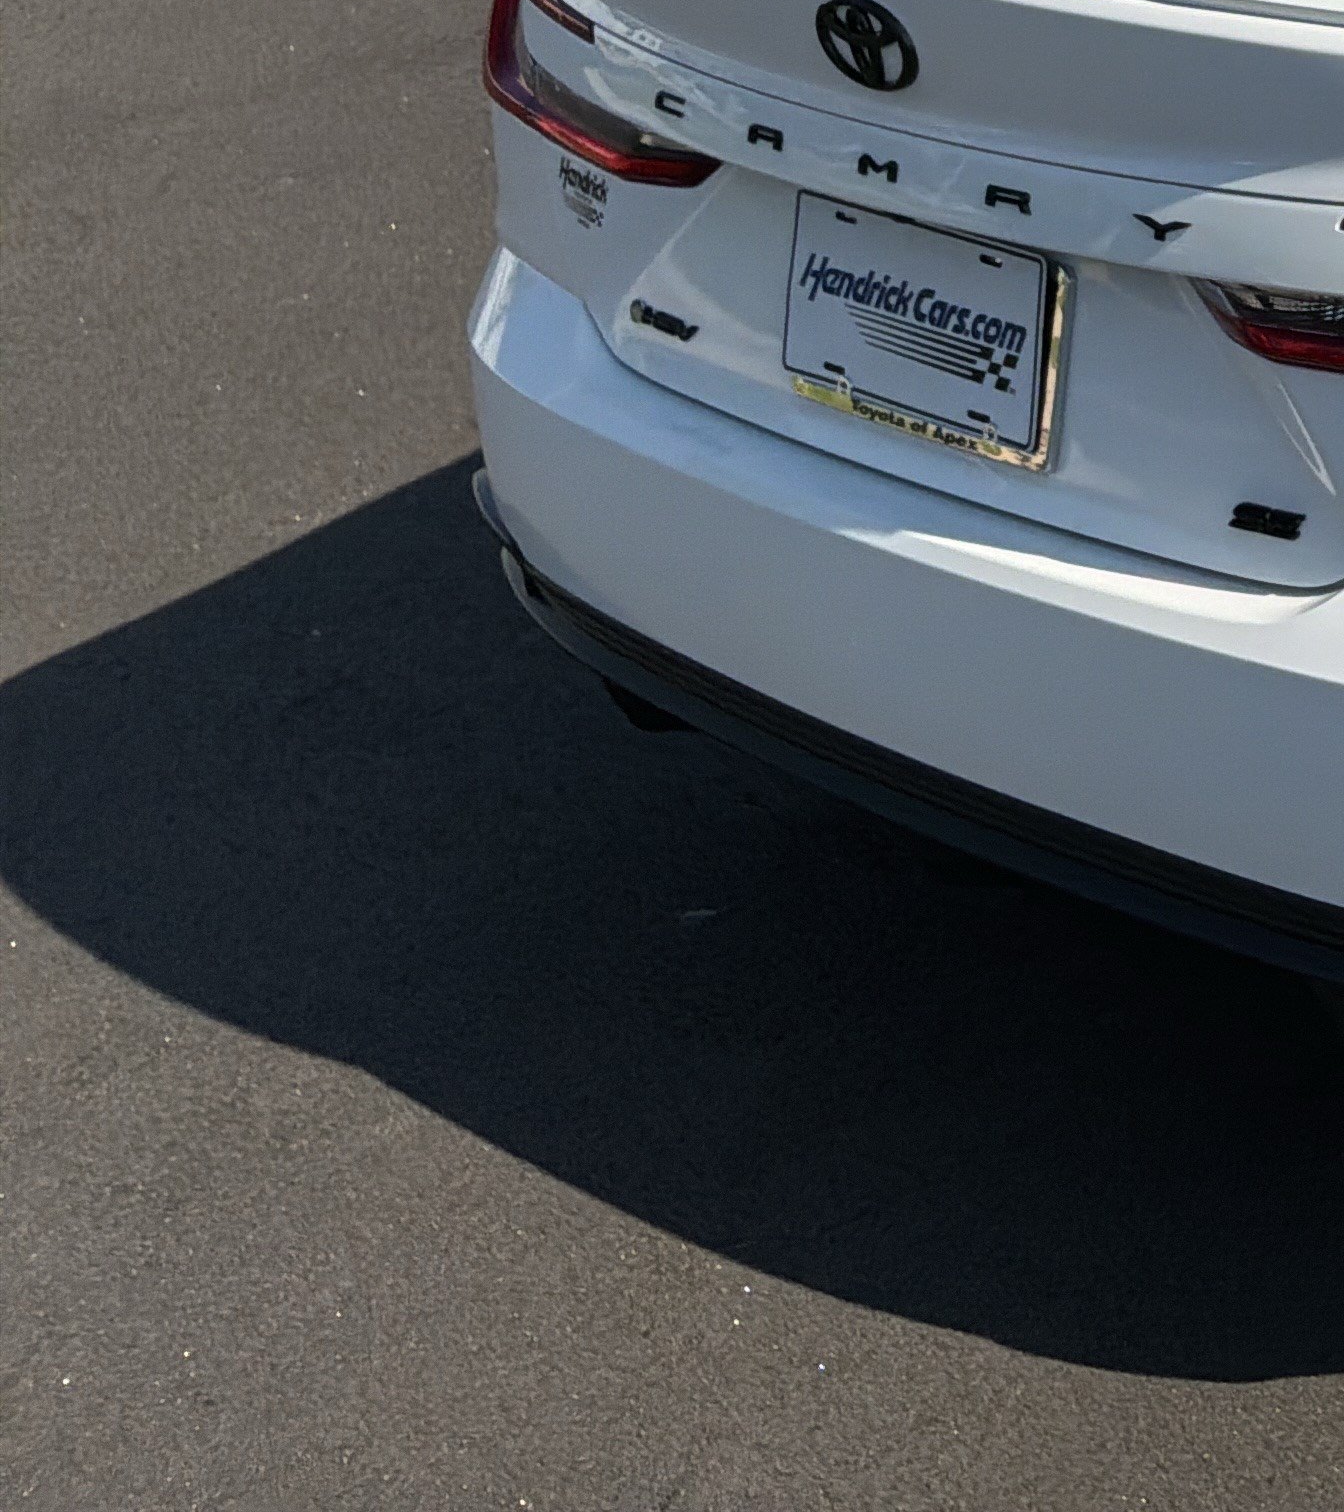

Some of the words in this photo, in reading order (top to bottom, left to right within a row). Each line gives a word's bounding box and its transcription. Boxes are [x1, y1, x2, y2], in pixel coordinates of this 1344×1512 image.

[654, 90, 1193, 242] CAMRY
[852, 396, 906, 429] Toyota
[910, 420, 929, 435] of
[933, 425, 978, 450] Apex
